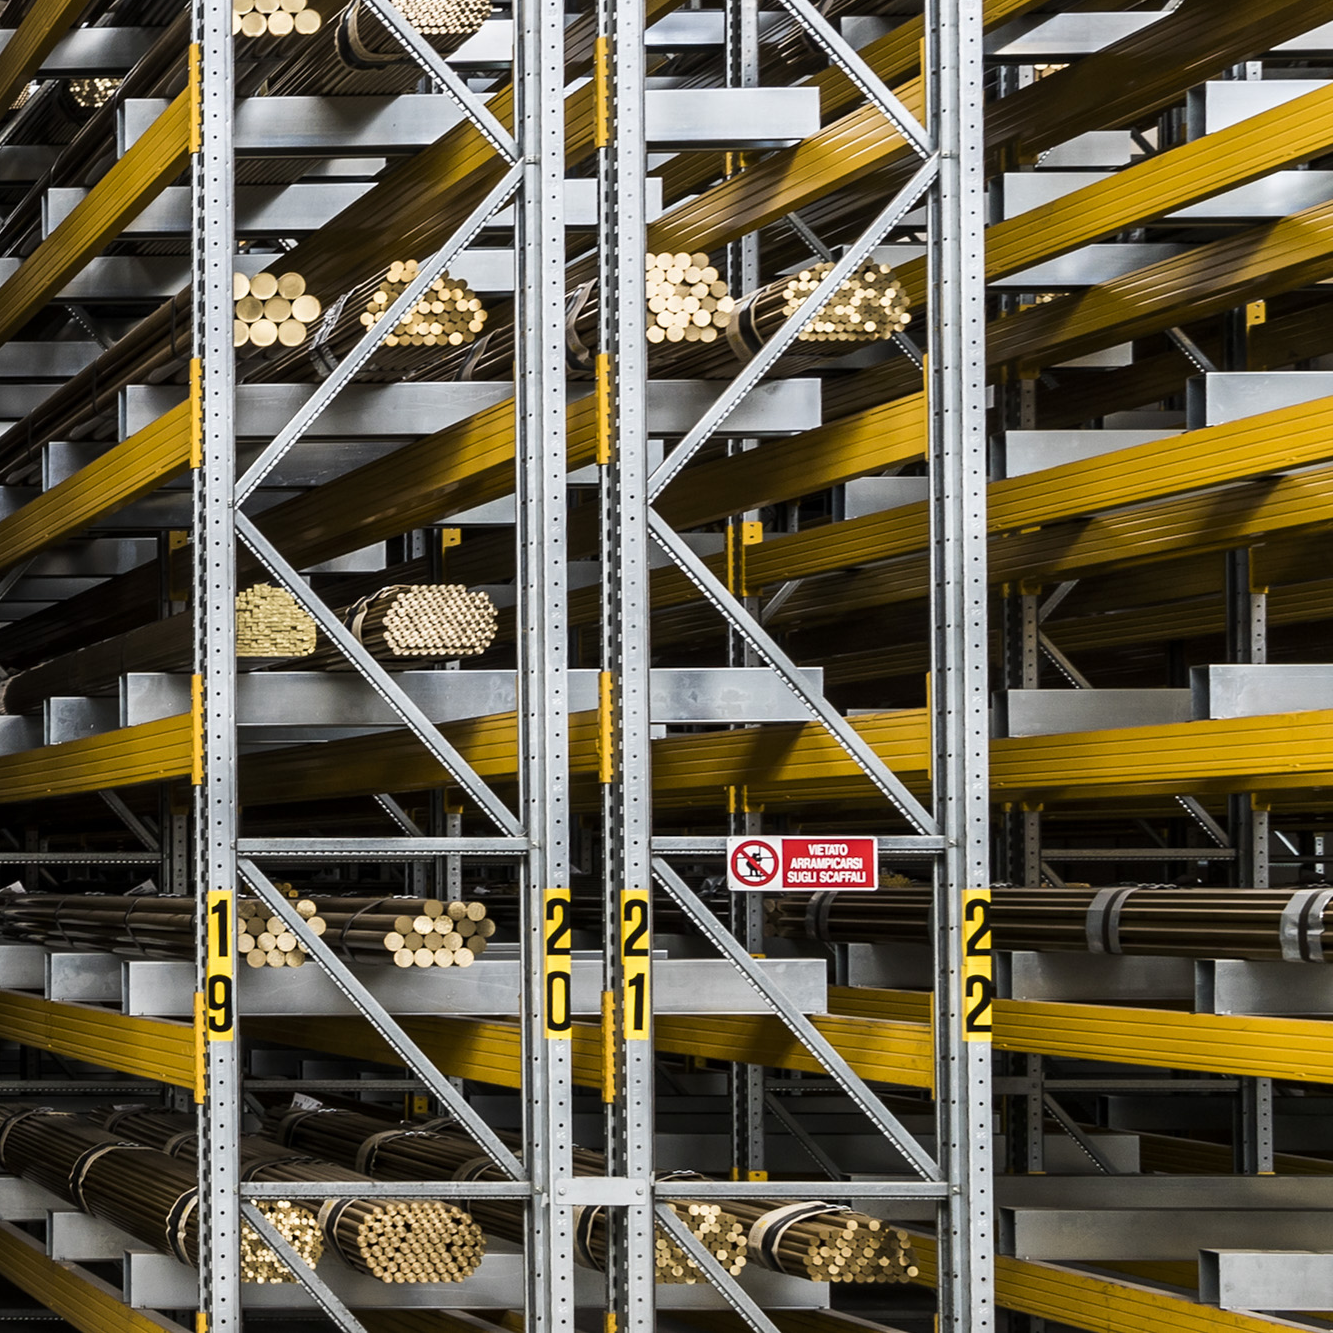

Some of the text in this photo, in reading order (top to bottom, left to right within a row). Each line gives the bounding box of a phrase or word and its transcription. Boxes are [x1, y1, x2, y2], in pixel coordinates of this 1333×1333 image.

[807, 843, 849, 855] VIETATO
[790, 857, 863, 870] ARRAMPICARSI
[787, 870, 866, 883] SUGLI SCAFFALI
